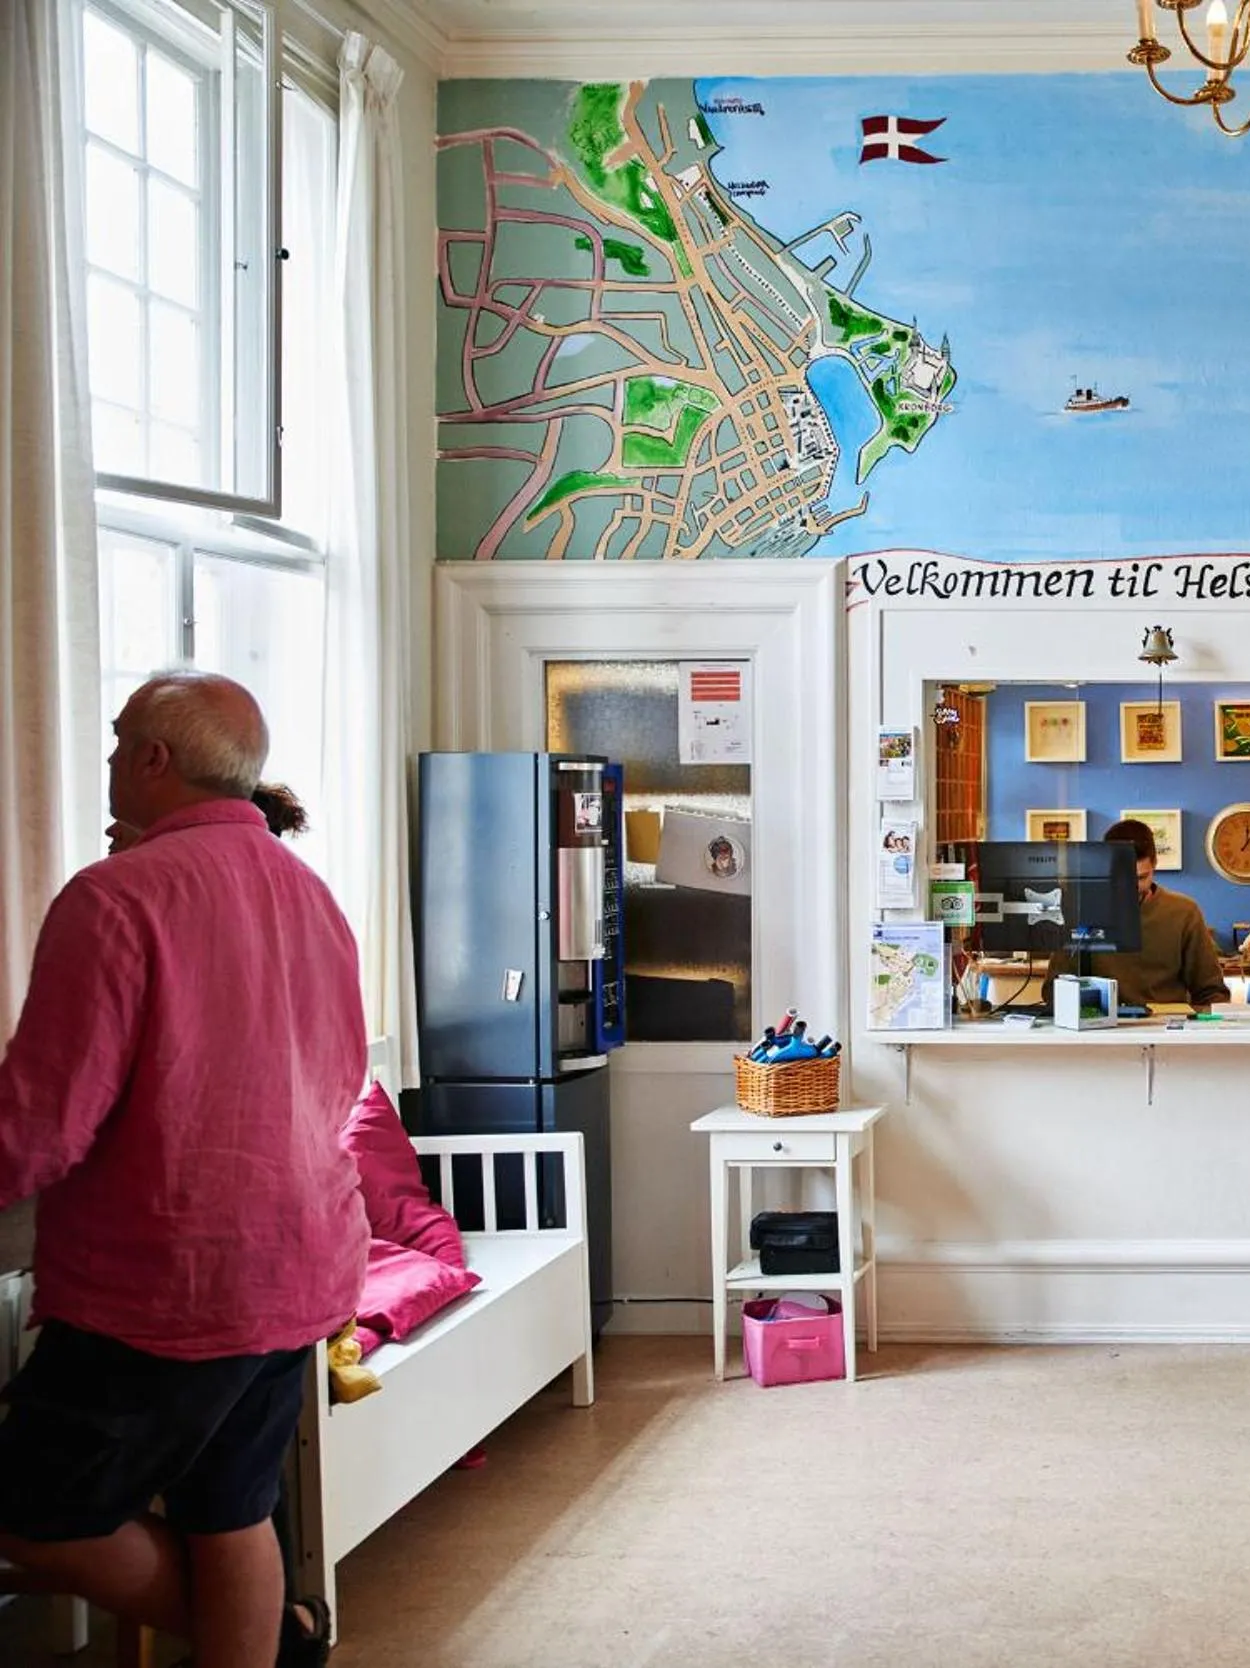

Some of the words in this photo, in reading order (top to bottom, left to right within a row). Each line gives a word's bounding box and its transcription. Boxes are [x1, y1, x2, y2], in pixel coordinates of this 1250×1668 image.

[899, 401, 953, 412] KRONBORG
[852, 559, 1095, 599] Velkommen
[1107, 563, 1163, 598] til
